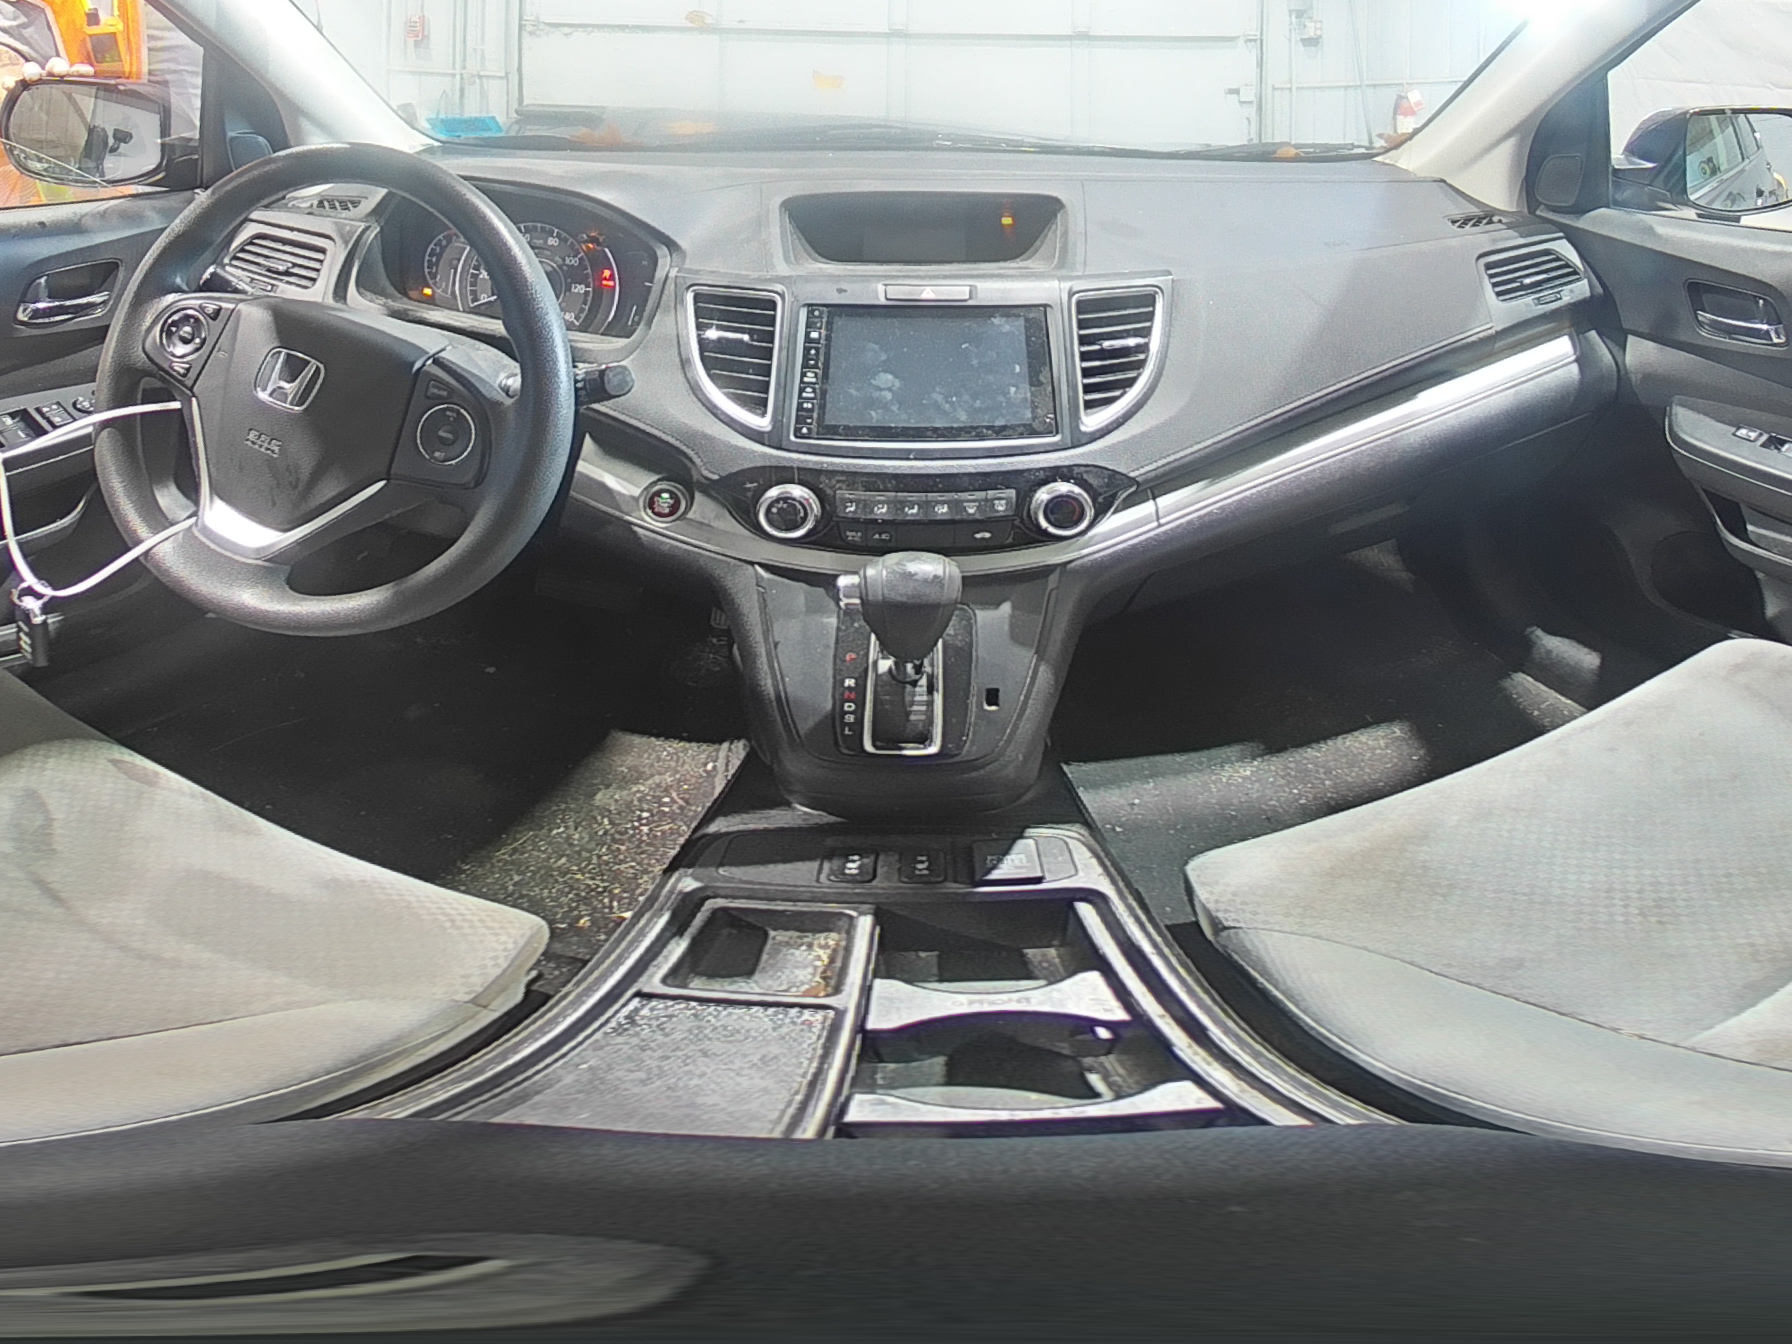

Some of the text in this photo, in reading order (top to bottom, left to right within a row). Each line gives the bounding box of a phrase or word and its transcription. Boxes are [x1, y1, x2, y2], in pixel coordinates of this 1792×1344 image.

[565, 256, 579, 266] 100
[571, 283, 585, 294] 120
[843, 678, 856, 687] R
[843, 702, 856, 711] D
[843, 714, 855, 723] S
[843, 726, 854, 735] L
